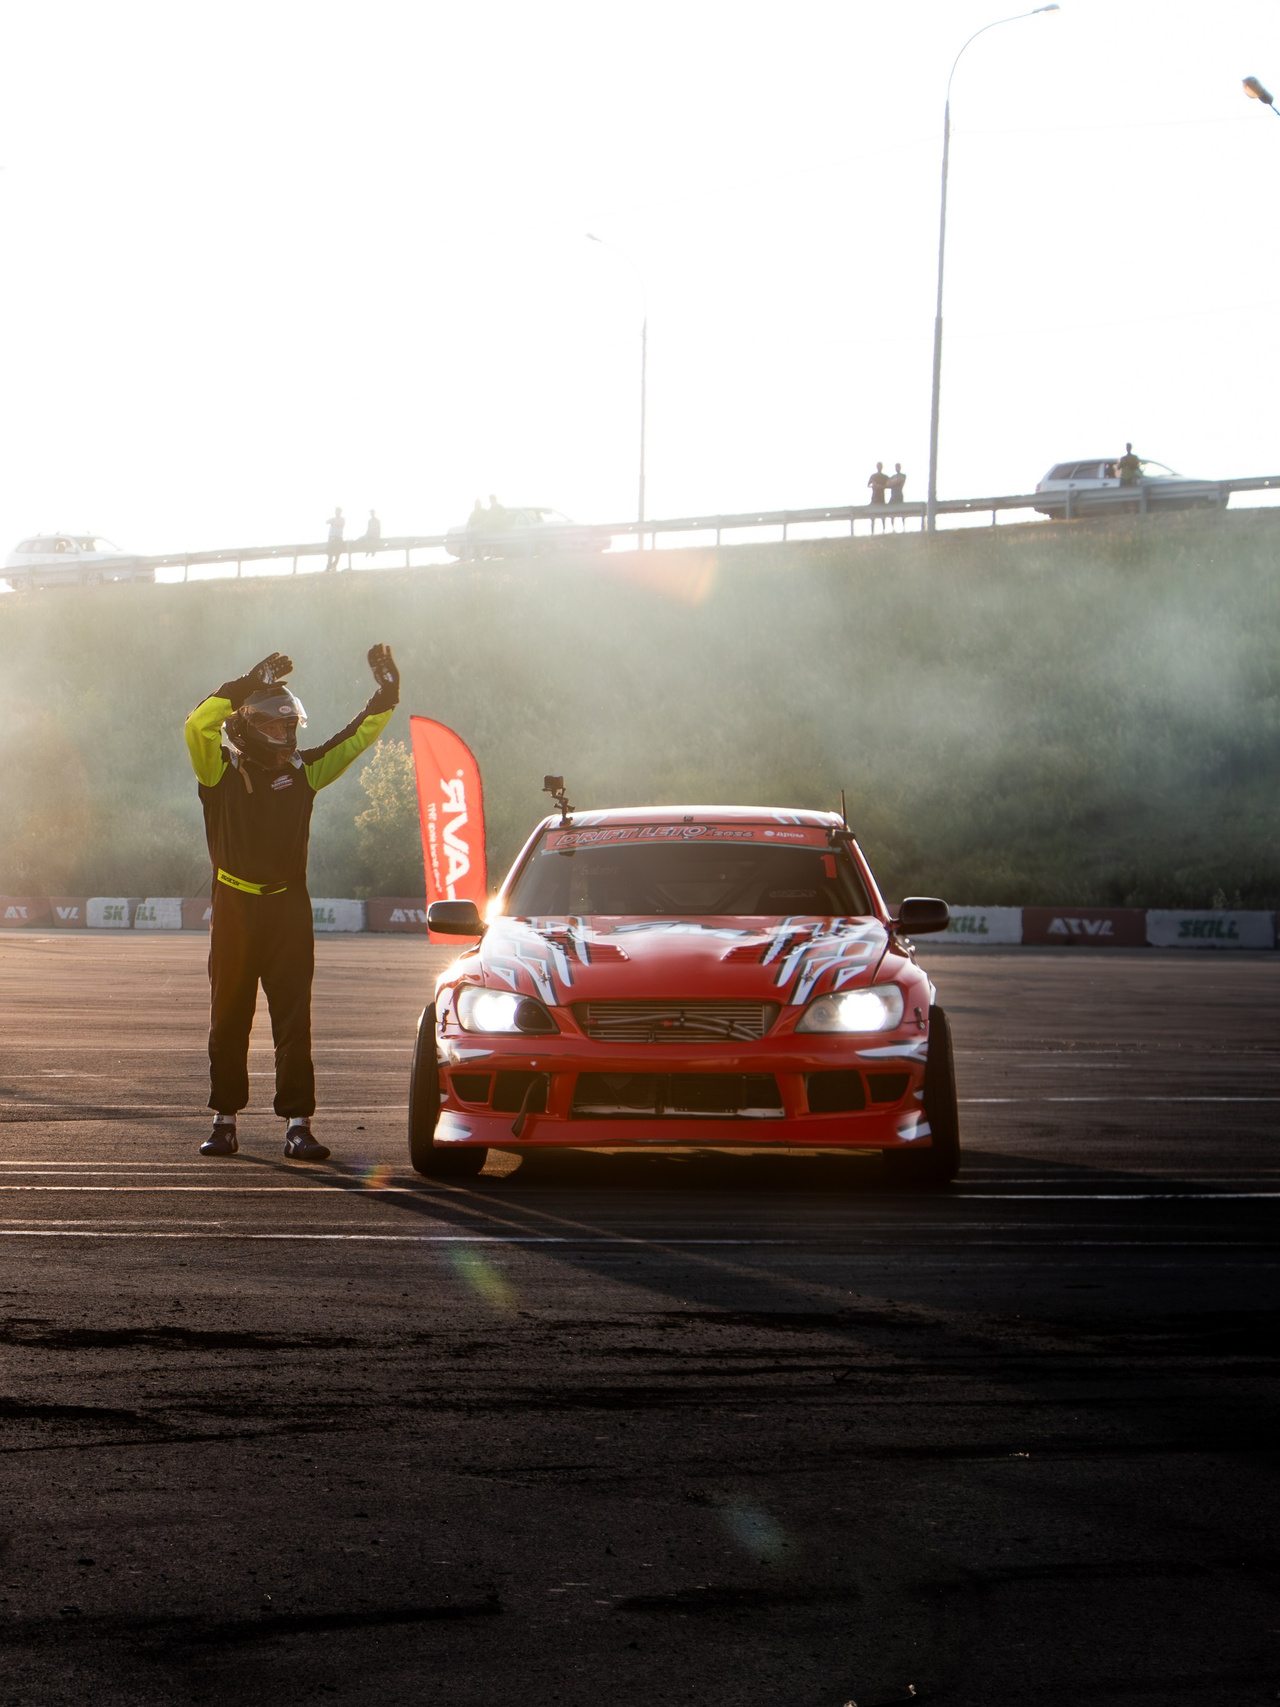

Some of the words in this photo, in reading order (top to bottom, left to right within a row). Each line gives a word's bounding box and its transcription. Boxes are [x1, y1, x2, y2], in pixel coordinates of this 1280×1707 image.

[556, 828, 637, 847] DRIFT
[636, 825, 708, 839] LETO
[946, 915, 989, 935] KILL
[1178, 919, 1240, 939] SKILL
